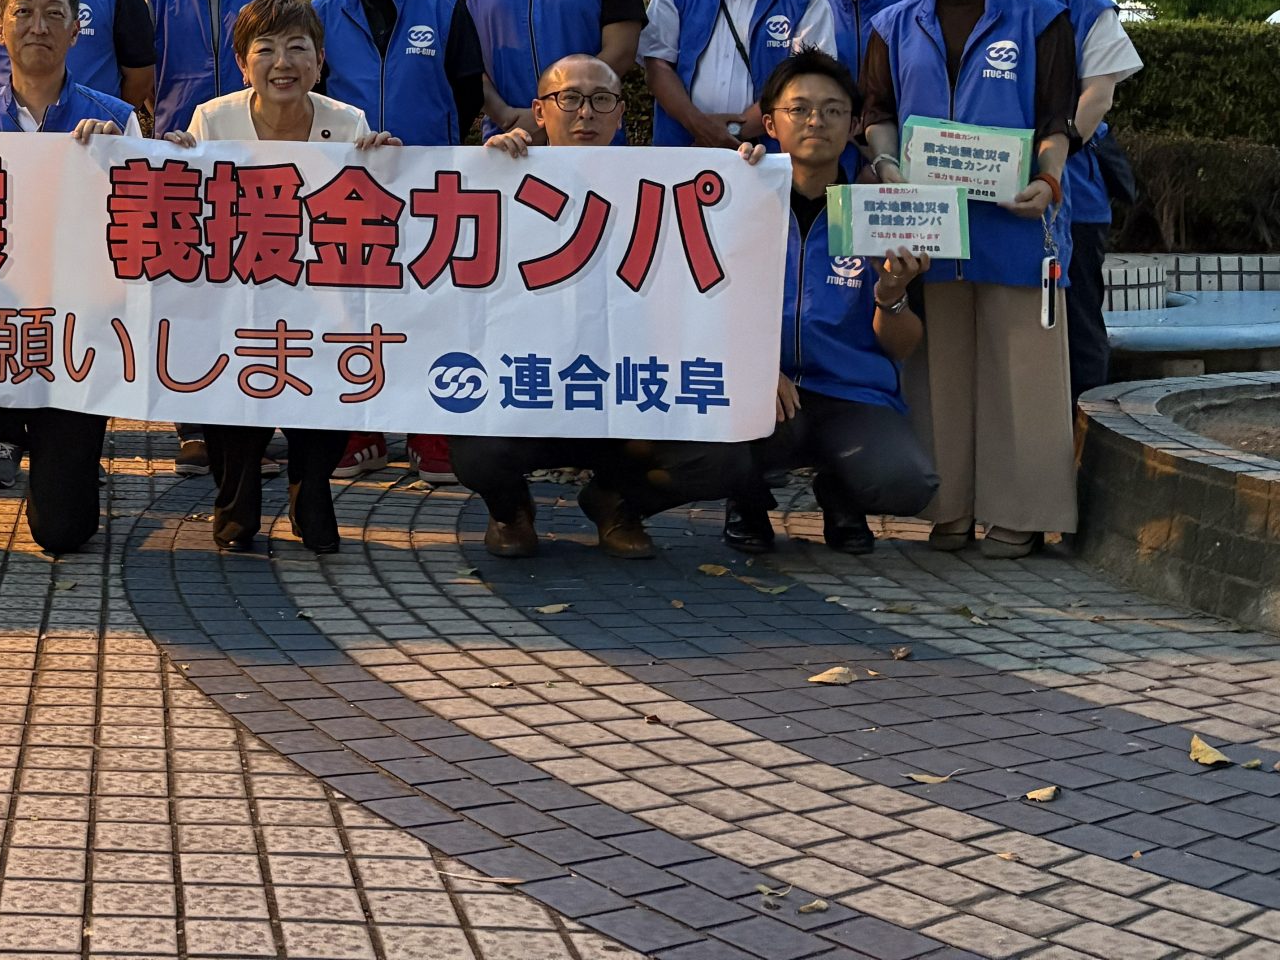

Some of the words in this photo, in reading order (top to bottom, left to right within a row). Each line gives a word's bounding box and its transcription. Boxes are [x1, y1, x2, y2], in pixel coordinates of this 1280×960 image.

[107, 157, 726, 295] 義援金カンパ
[499, 354, 730, 415] 連合岐阜
